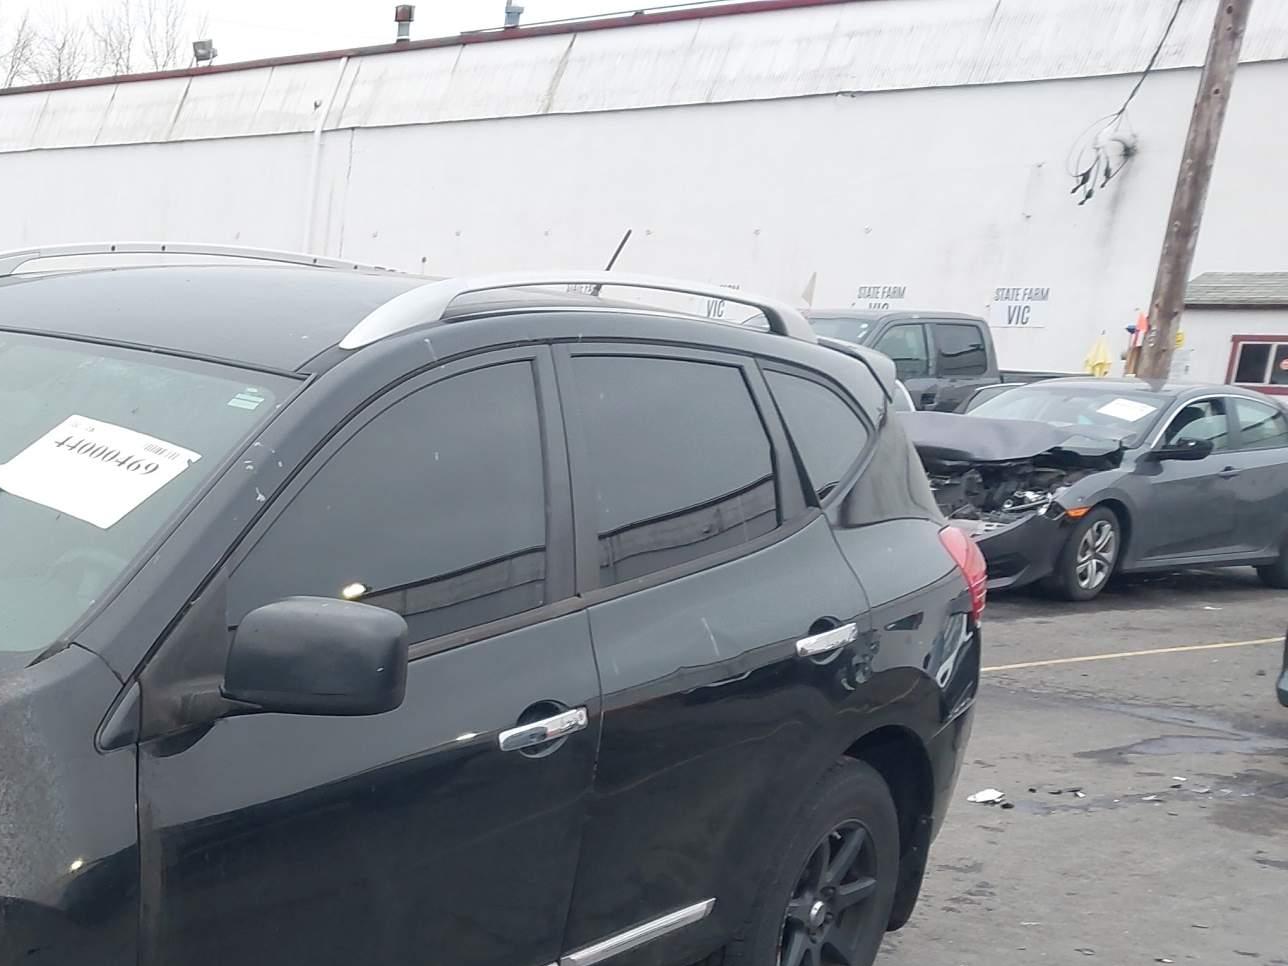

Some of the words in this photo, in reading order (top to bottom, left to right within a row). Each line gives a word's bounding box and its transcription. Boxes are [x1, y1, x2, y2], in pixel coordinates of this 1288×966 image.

[857, 286, 880, 300] STATE
[881, 286, 907, 300] FARM
[994, 287, 1020, 301] STATE
[1021, 287, 1050, 301] FARM
[706, 299, 725, 318] VIC
[1006, 304, 1031, 325] VIC
[53, 435, 161, 475] 44000469
